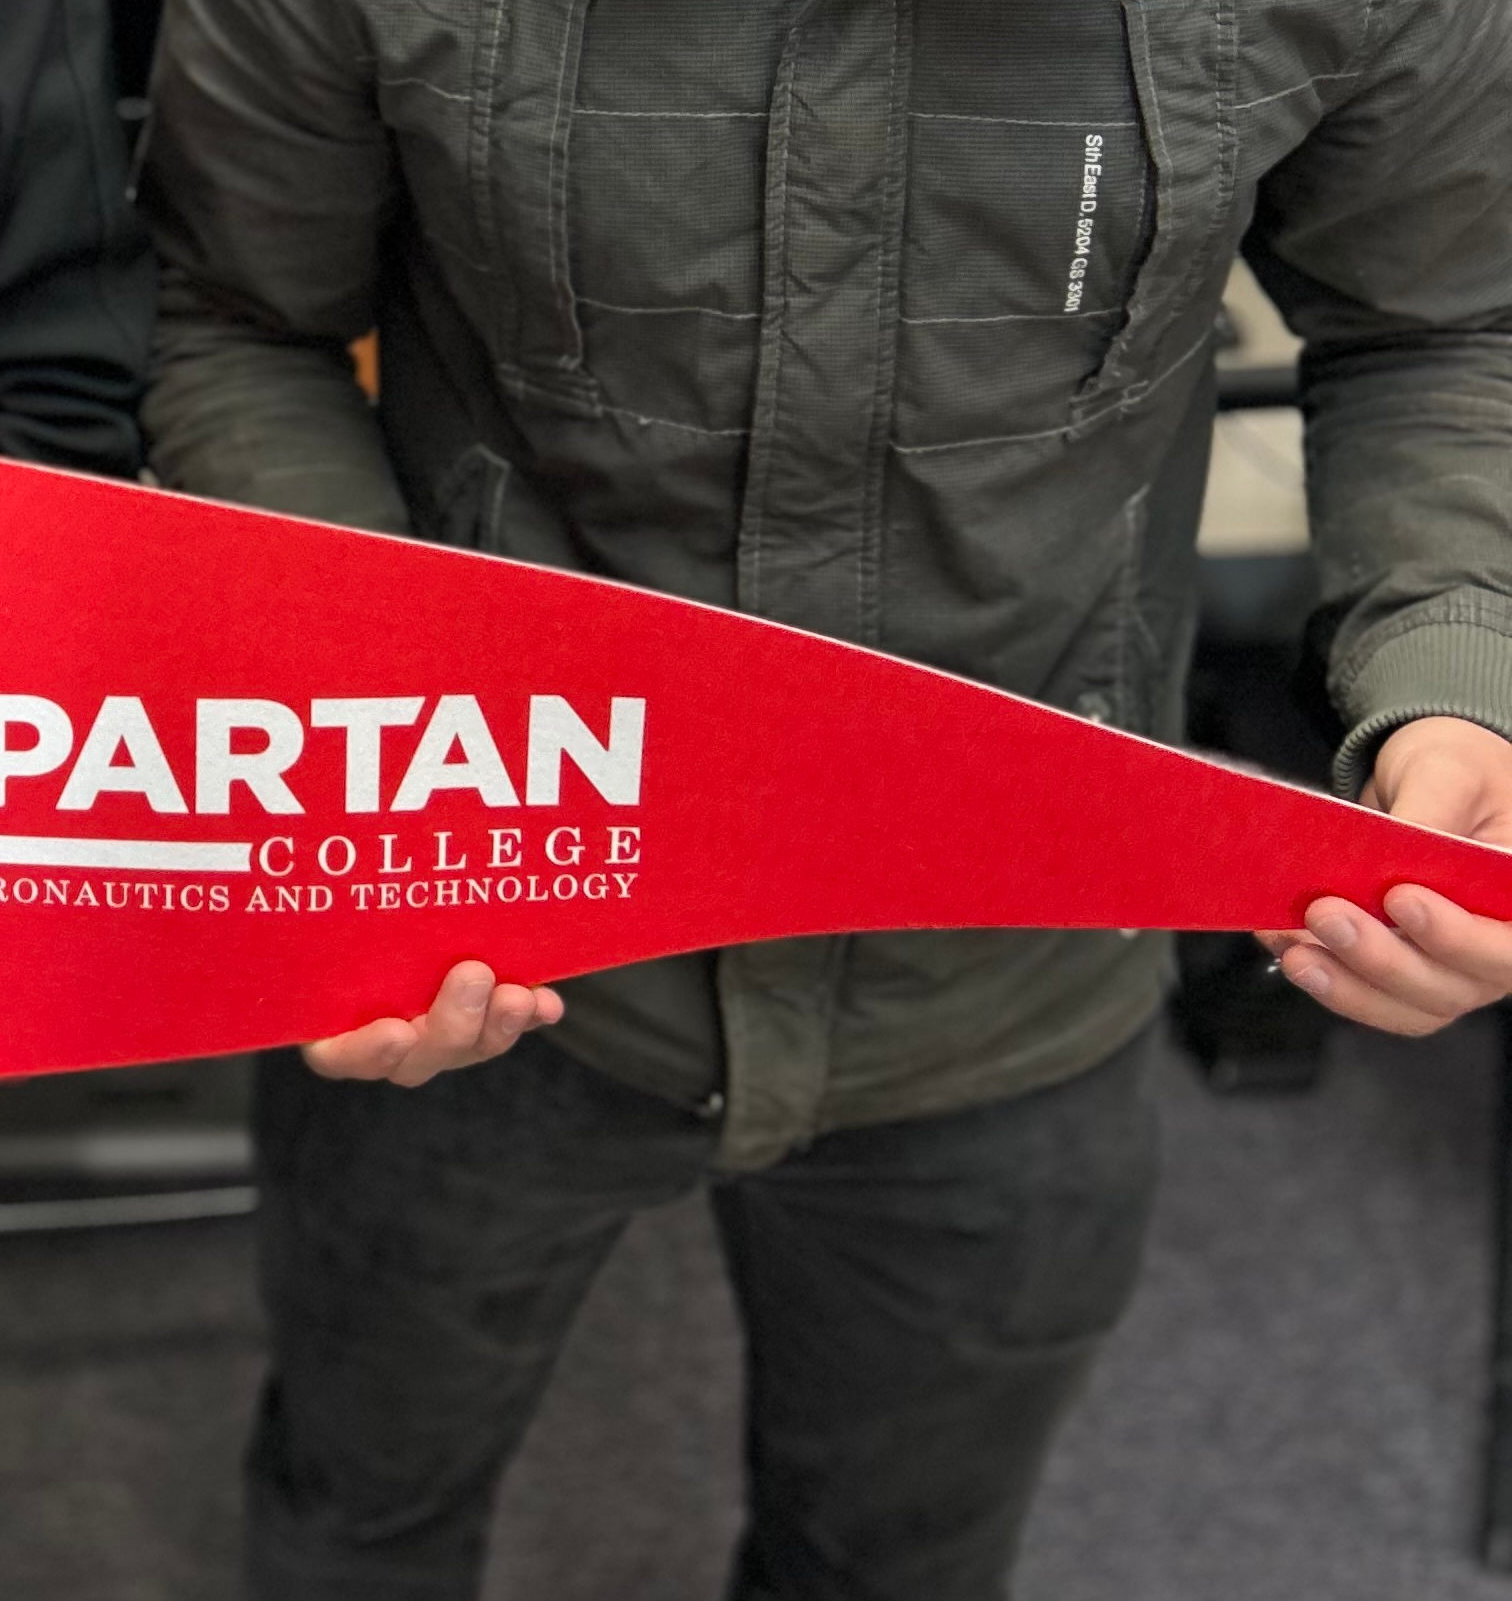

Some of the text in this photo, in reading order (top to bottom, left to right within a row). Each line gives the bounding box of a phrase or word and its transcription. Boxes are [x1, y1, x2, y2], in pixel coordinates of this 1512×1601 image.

[258, 826, 646, 877] COLLEGE
[245, 885, 333, 912] AND
[350, 873, 638, 910] TECHNOLOGY
